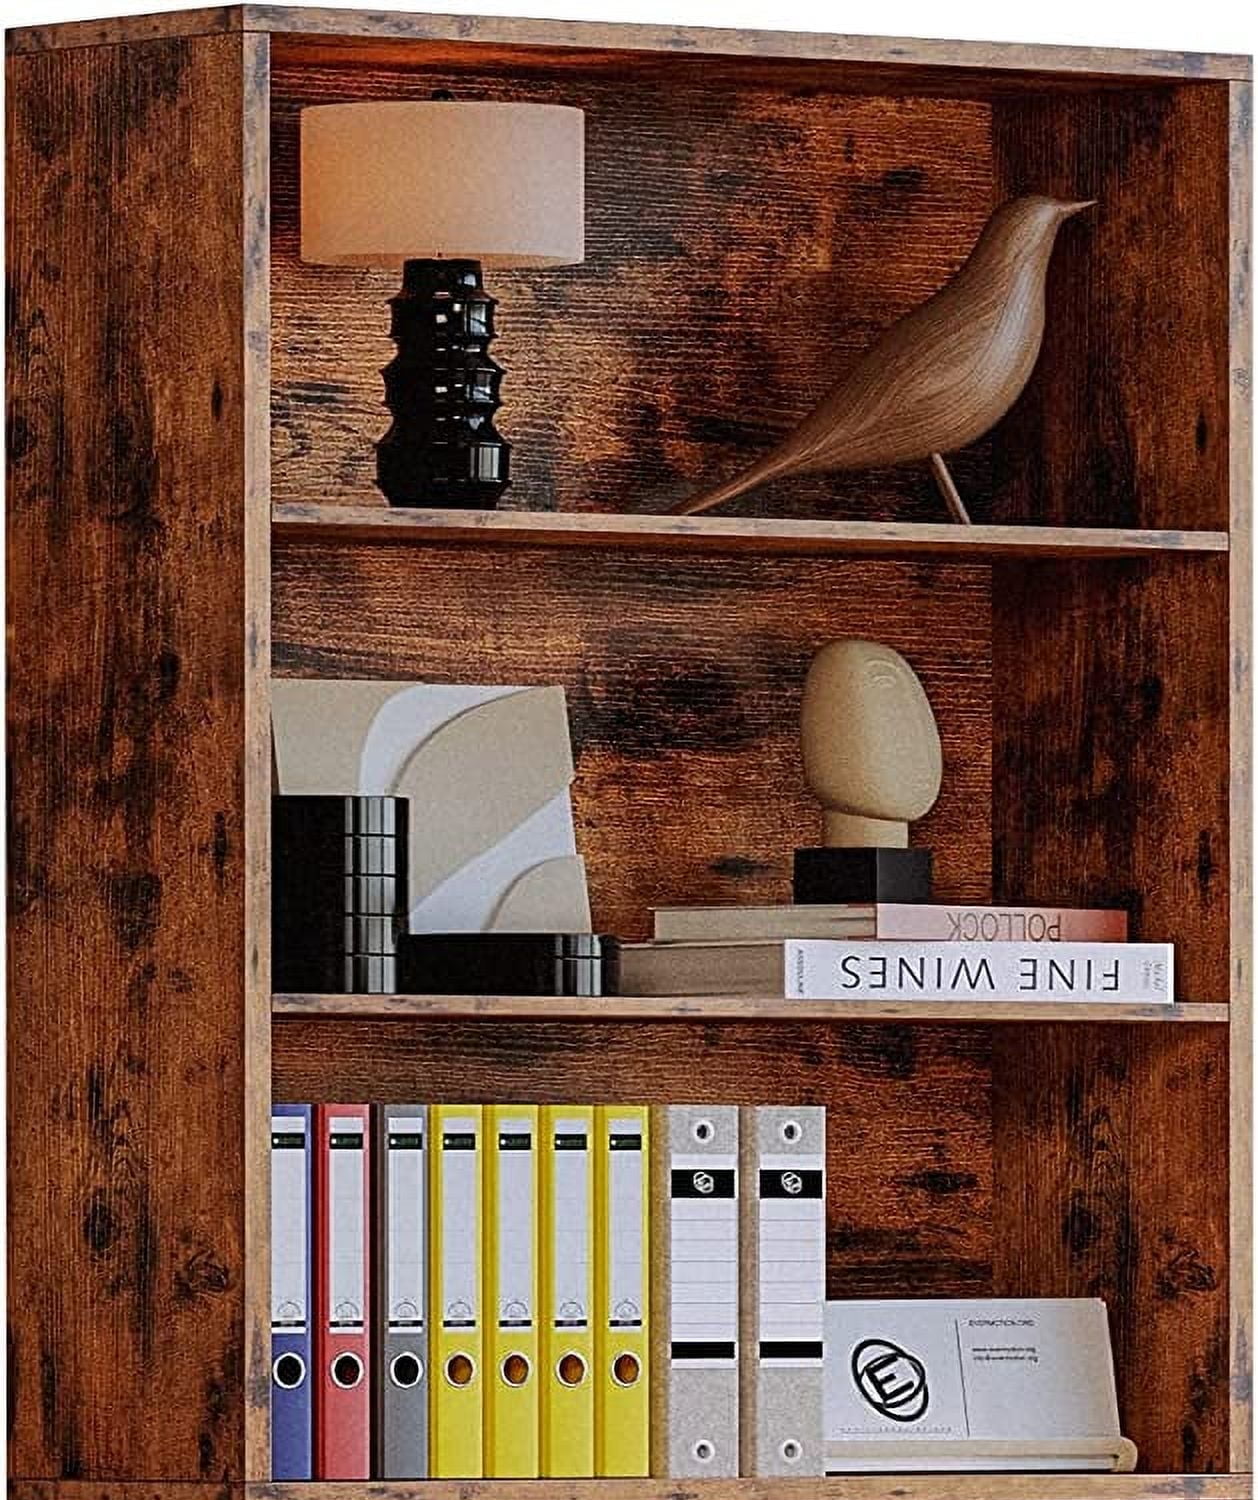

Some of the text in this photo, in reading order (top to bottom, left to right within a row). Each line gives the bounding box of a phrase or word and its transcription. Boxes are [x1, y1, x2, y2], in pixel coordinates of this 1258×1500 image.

[946, 912, 1062, 942] POLLOCK
[840, 955, 996, 990] WINES
[1019, 958, 1120, 991] FINE
